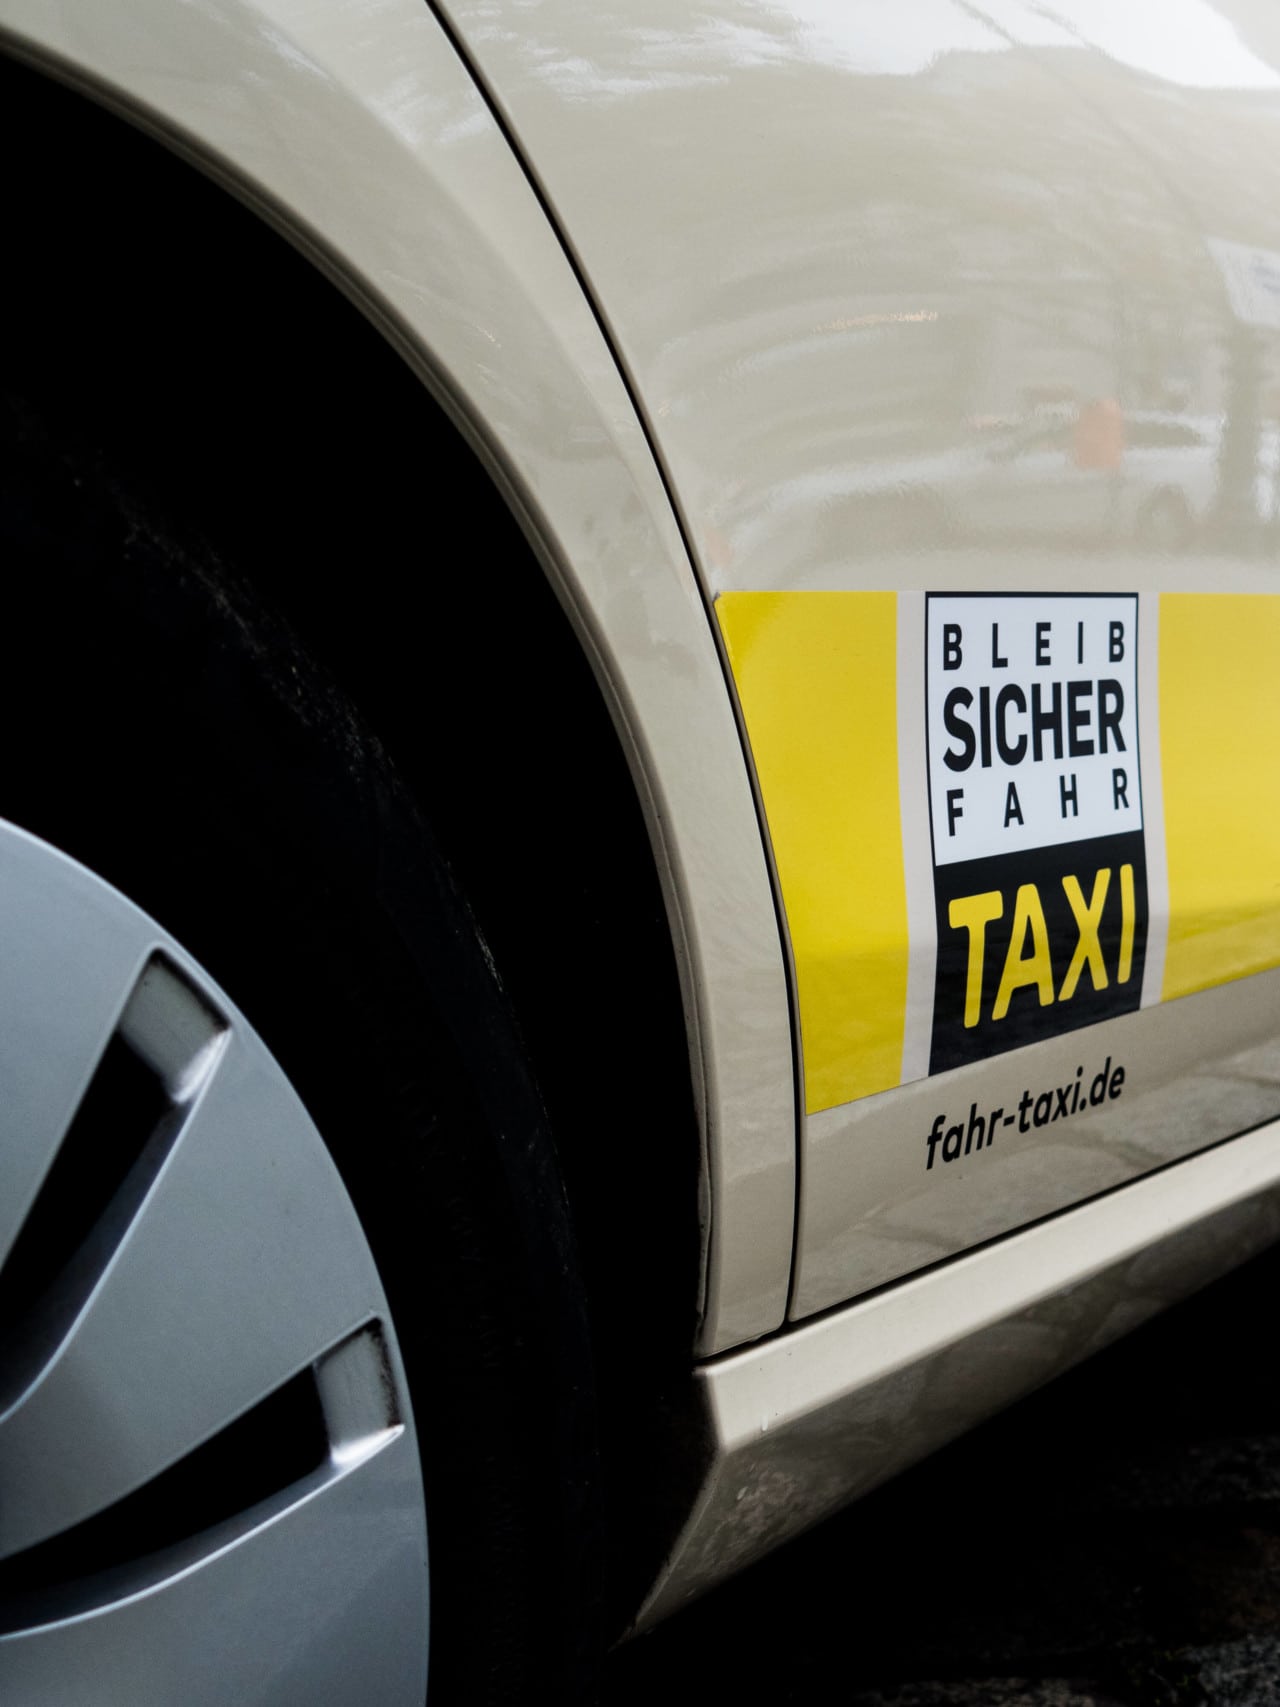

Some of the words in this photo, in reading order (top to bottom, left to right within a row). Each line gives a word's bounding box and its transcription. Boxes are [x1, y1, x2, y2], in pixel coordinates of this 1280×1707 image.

[943, 621, 1125, 670] BLEIB
[943, 679, 1127, 772] SICHER
[946, 768, 1129, 837] FAHR
[948, 864, 1136, 1028] TAXI
[926, 1056, 1125, 1170] fahr-taxi.de
